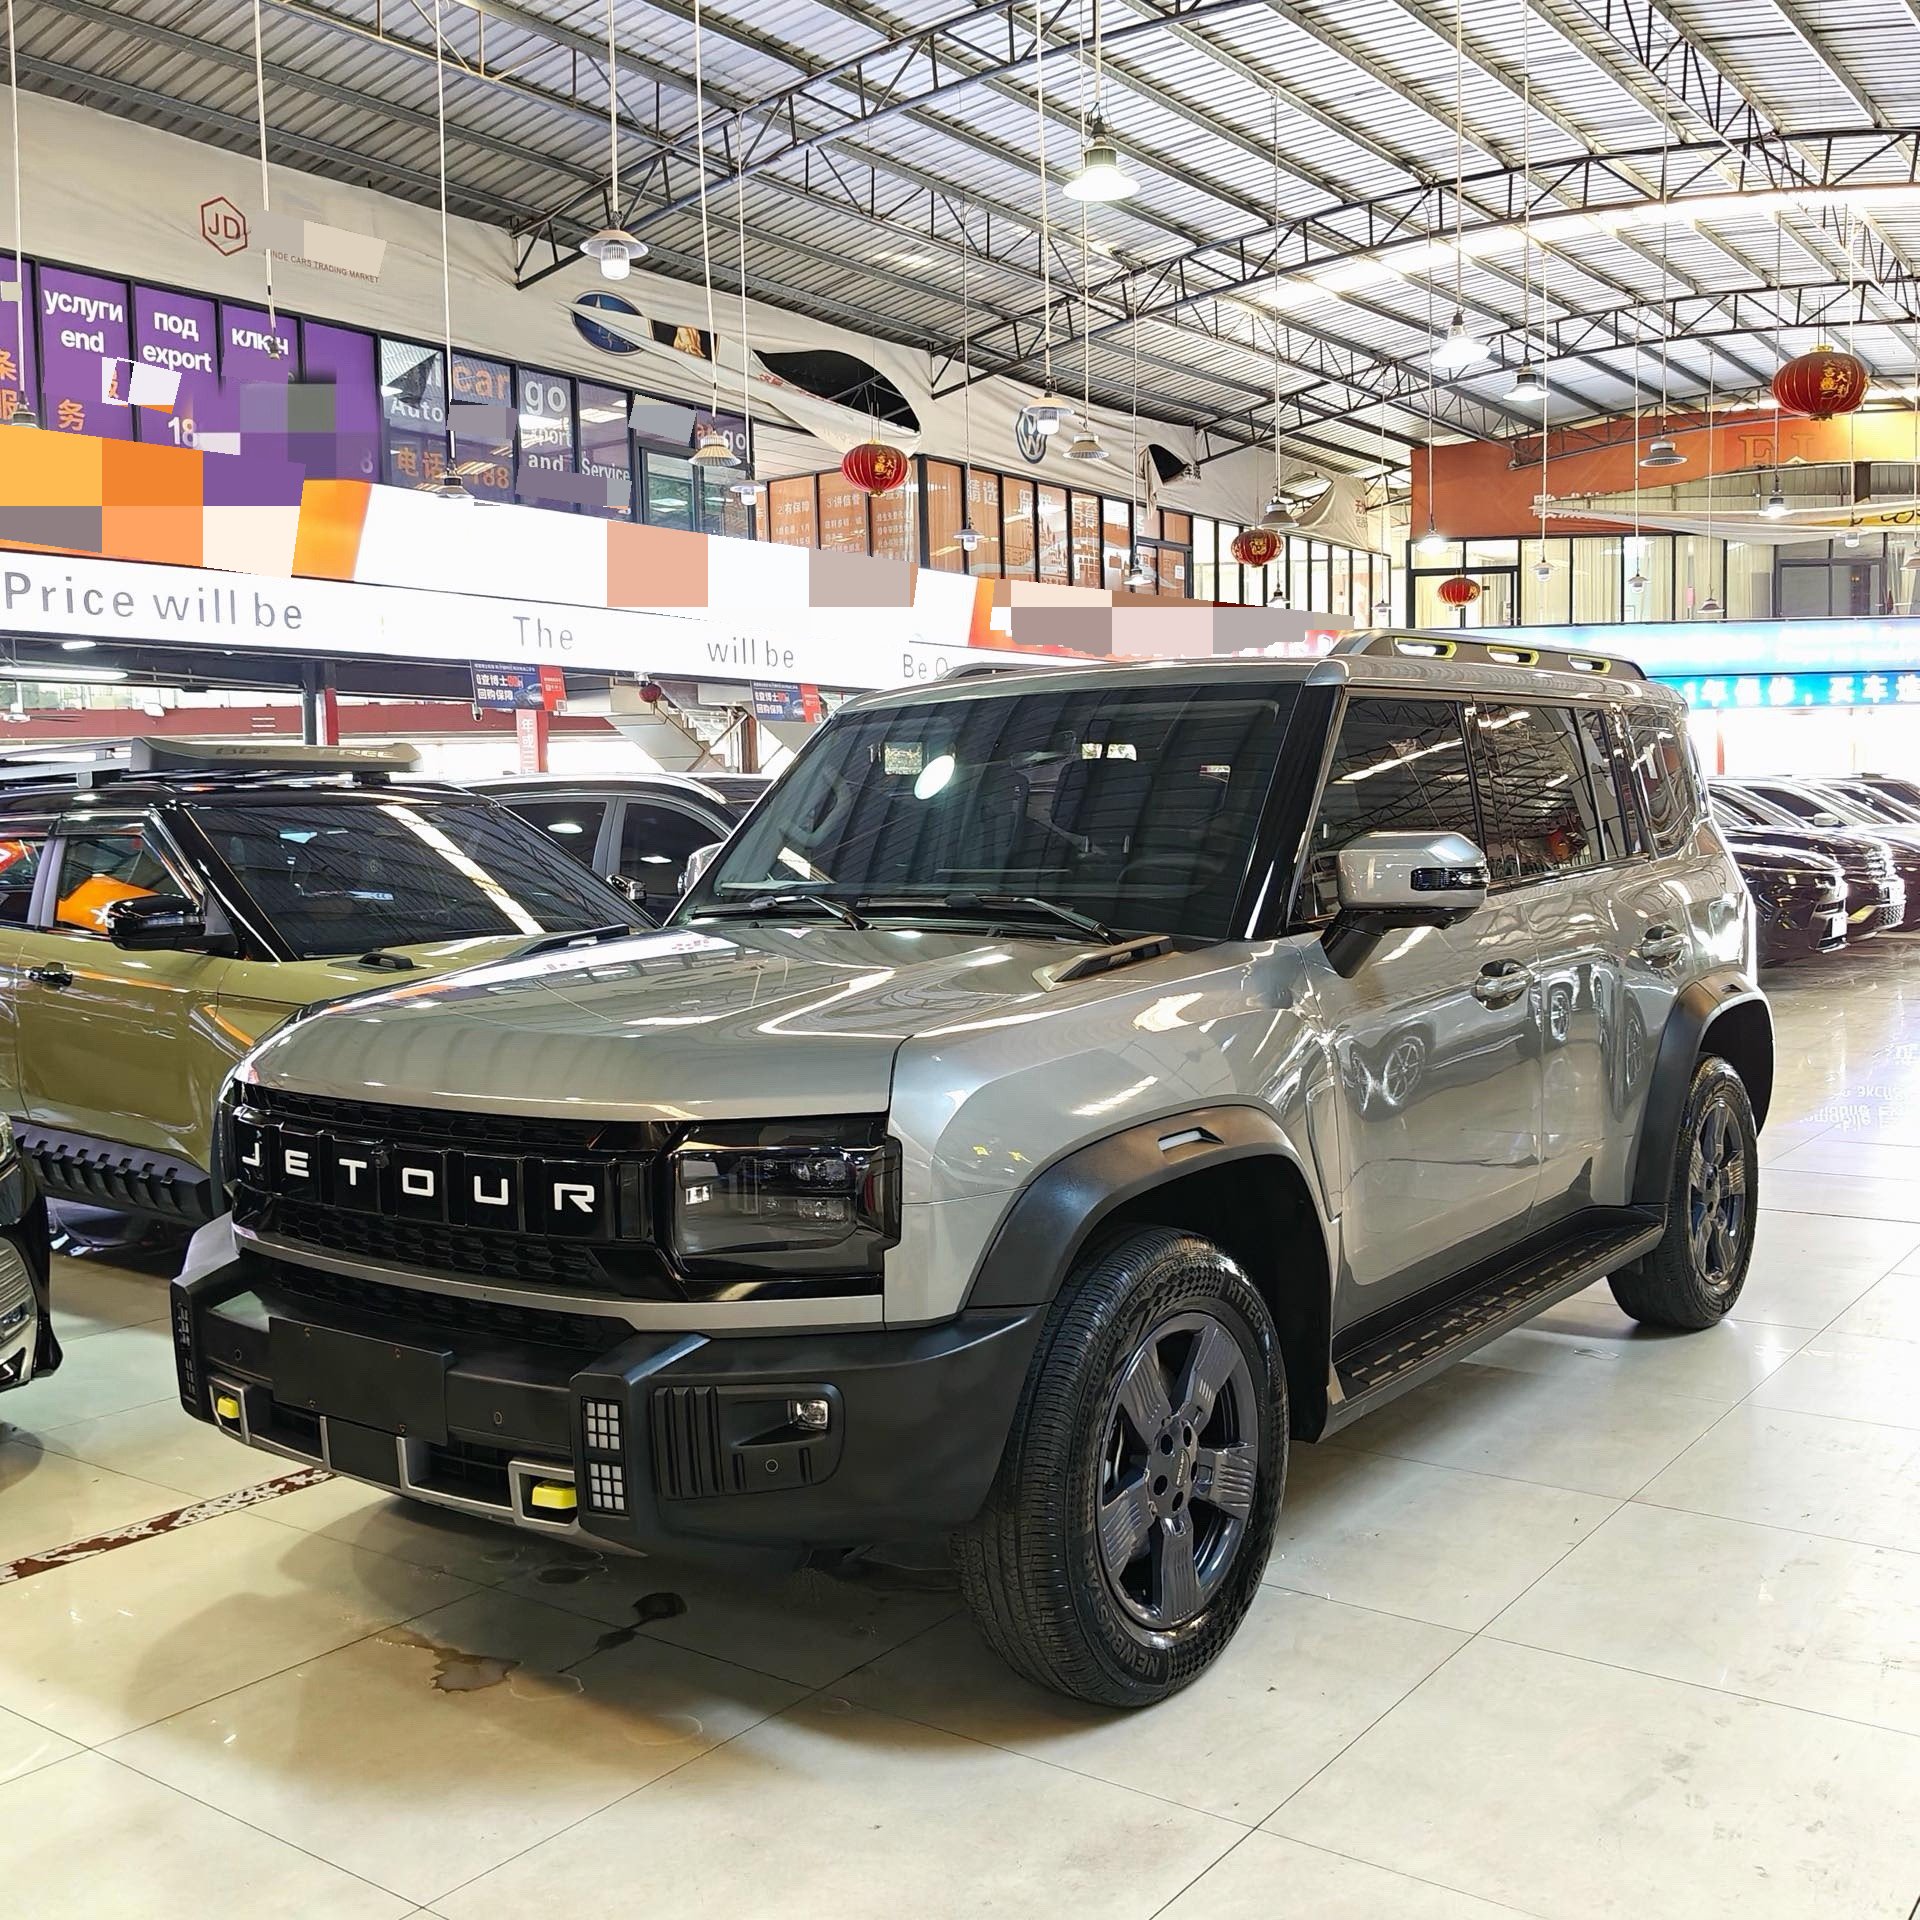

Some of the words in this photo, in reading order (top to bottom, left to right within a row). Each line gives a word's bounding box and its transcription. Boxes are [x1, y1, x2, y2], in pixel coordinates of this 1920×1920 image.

[208, 213, 241, 240] JD
[290, 255, 312, 268] CARS
[314, 260, 347, 276] TRADING
[348, 269, 379, 284] MARKET
[44, 288, 124, 323] услуги
[154, 311, 200, 342] под
[60, 329, 105, 353] end
[142, 344, 213, 374] export
[391, 398, 444, 422] Auto
[453, 364, 509, 400] car
[525, 381, 566, 415] go
[528, 454, 564, 472] and
[581, 457, 631, 481] Service
[4, 571, 134, 617] Price
[153, 587, 237, 625] will
[254, 592, 303, 630] be
[513, 615, 574, 651] The
[706, 636, 756, 666] will
[765, 640, 795, 669] be
[903, 653, 928, 680] Be
[241, 1141, 596, 1213] JETOUR
